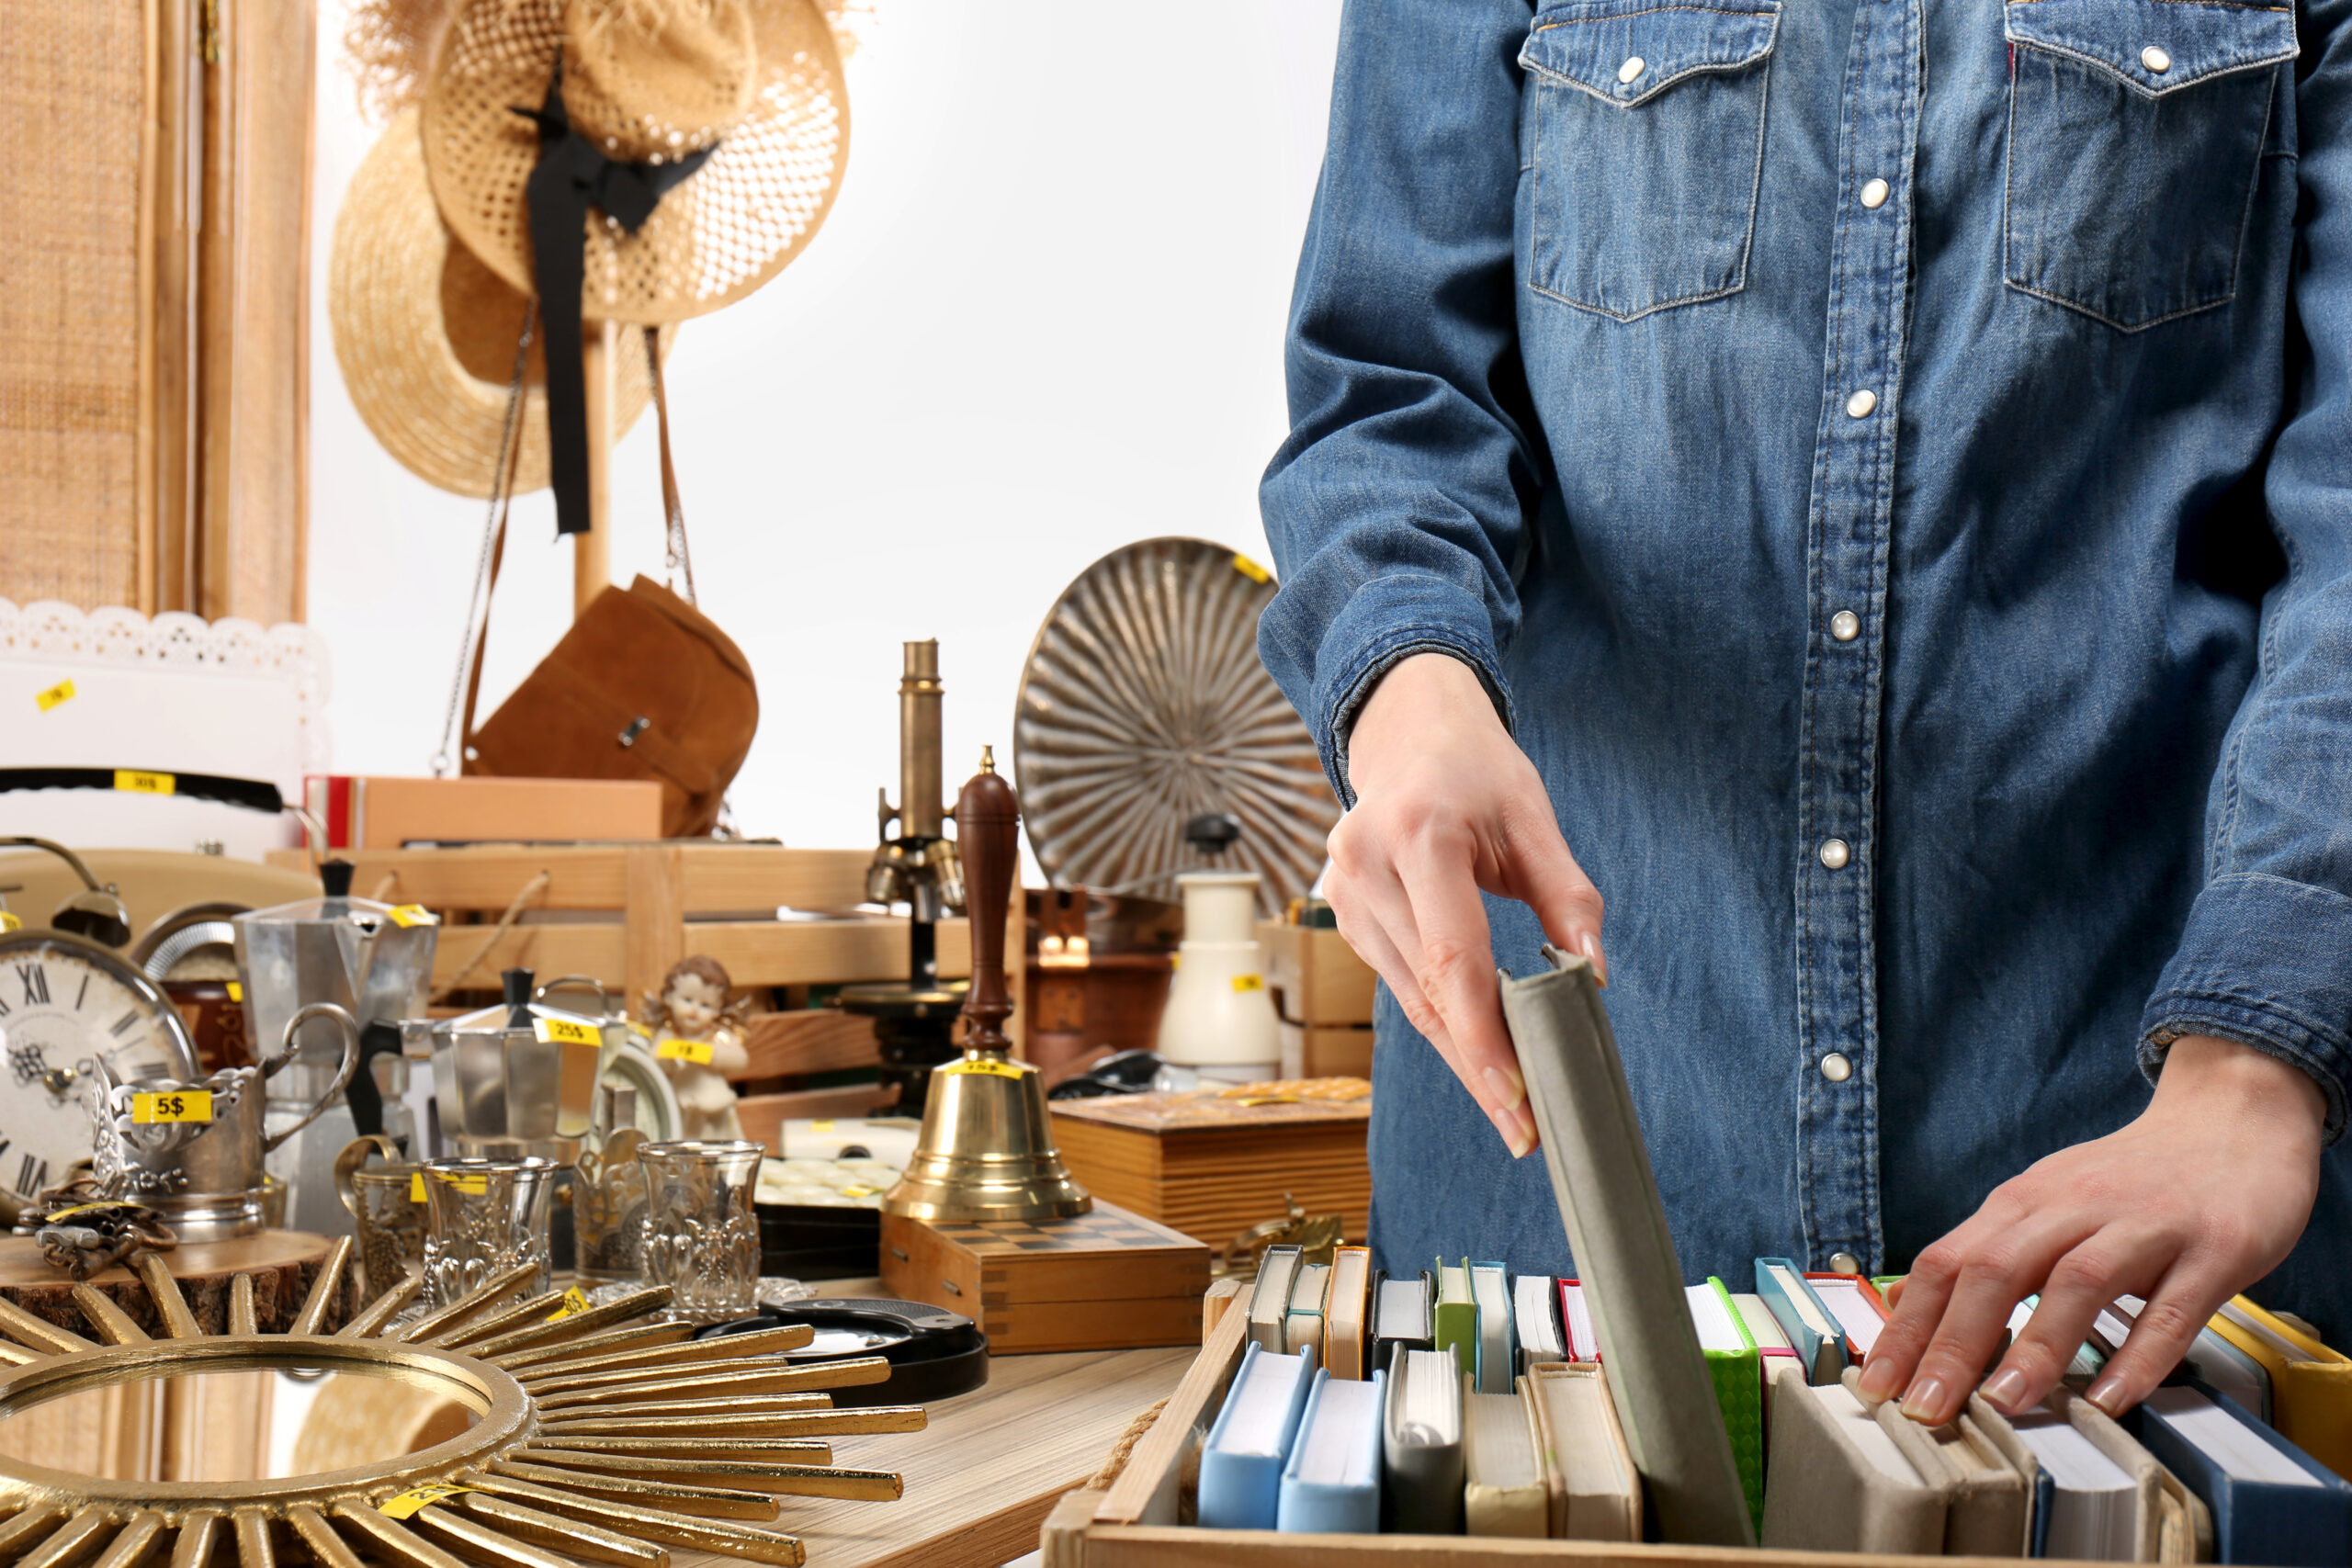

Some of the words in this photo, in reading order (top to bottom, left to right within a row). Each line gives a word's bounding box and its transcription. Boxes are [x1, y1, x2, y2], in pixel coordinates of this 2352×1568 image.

[16, 963, 51, 1006] XII
[555, 1022, 584, 1040] 25$
[157, 1096, 185, 1118] 5$
